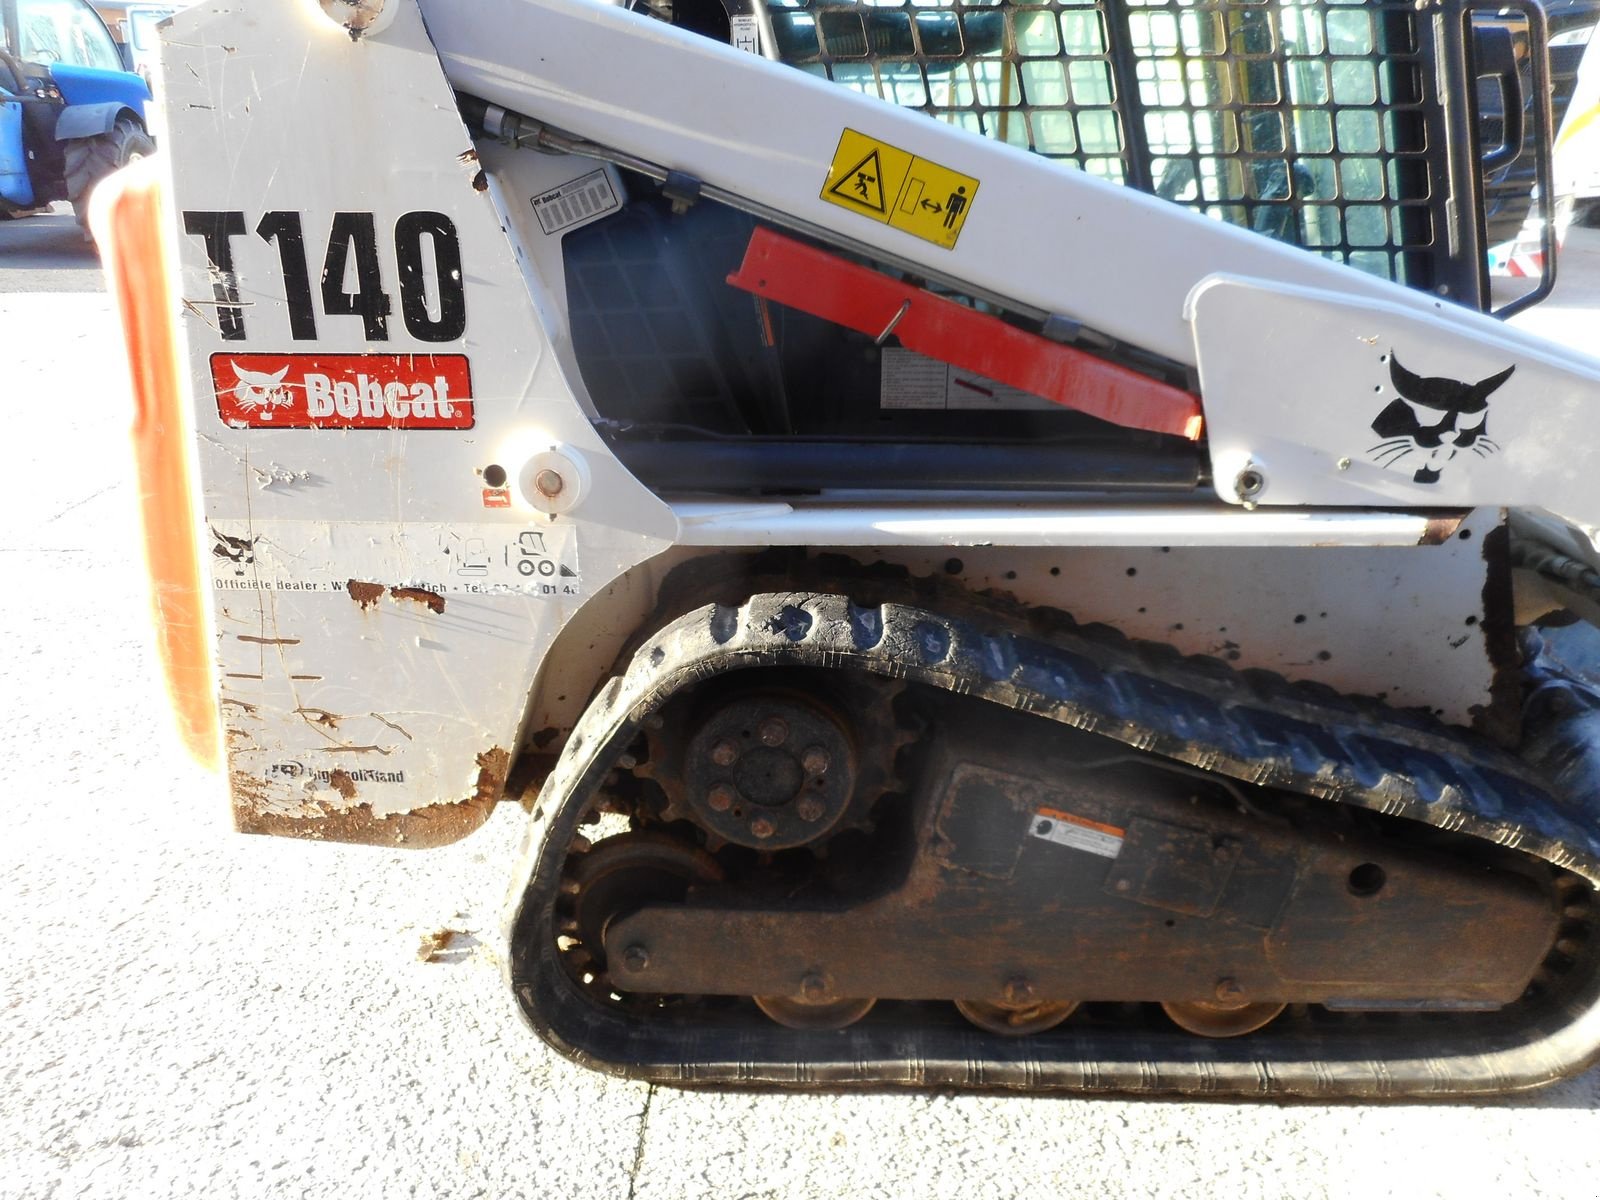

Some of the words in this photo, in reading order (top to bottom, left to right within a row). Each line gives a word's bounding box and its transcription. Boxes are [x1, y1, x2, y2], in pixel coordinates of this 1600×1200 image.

[181, 210, 467, 342] T140
[303, 373, 454, 419] Bobcat
[276, 580, 318, 591] dealer
